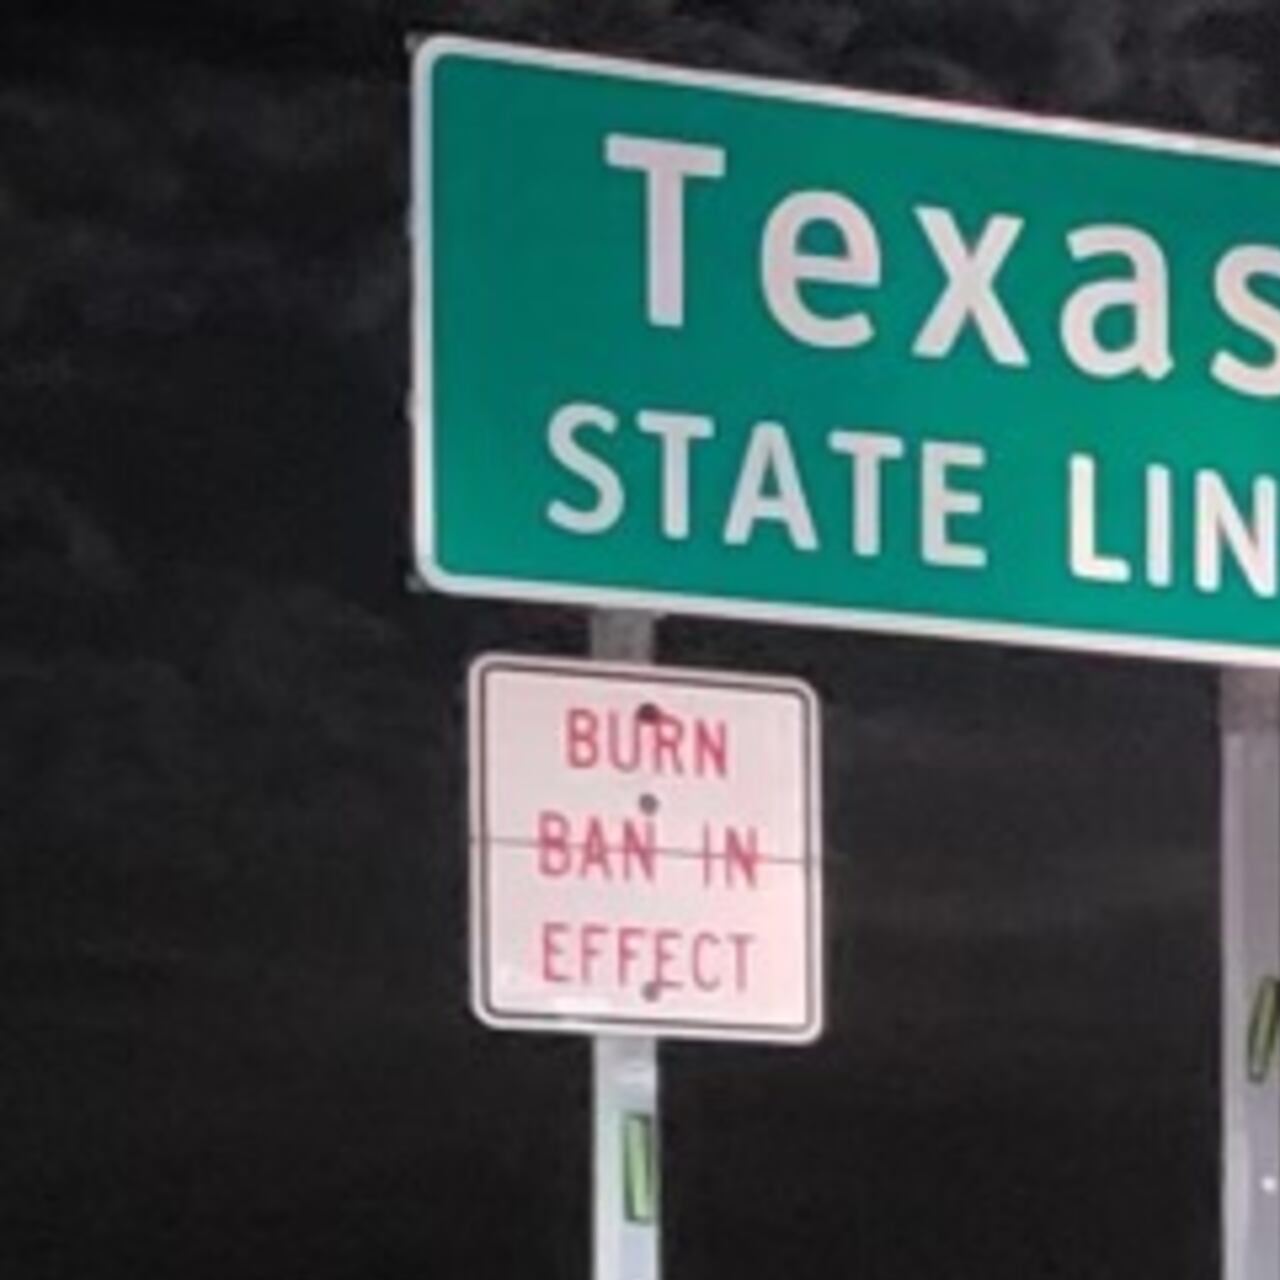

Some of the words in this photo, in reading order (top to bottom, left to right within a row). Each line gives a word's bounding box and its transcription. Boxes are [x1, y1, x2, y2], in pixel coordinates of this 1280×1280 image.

[546, 402, 987, 567] STATE
[566, 706, 729, 779] BURN
[537, 810, 656, 882] BAN
[702, 822, 760, 889] IN
[541, 922, 755, 993] EFFECT
